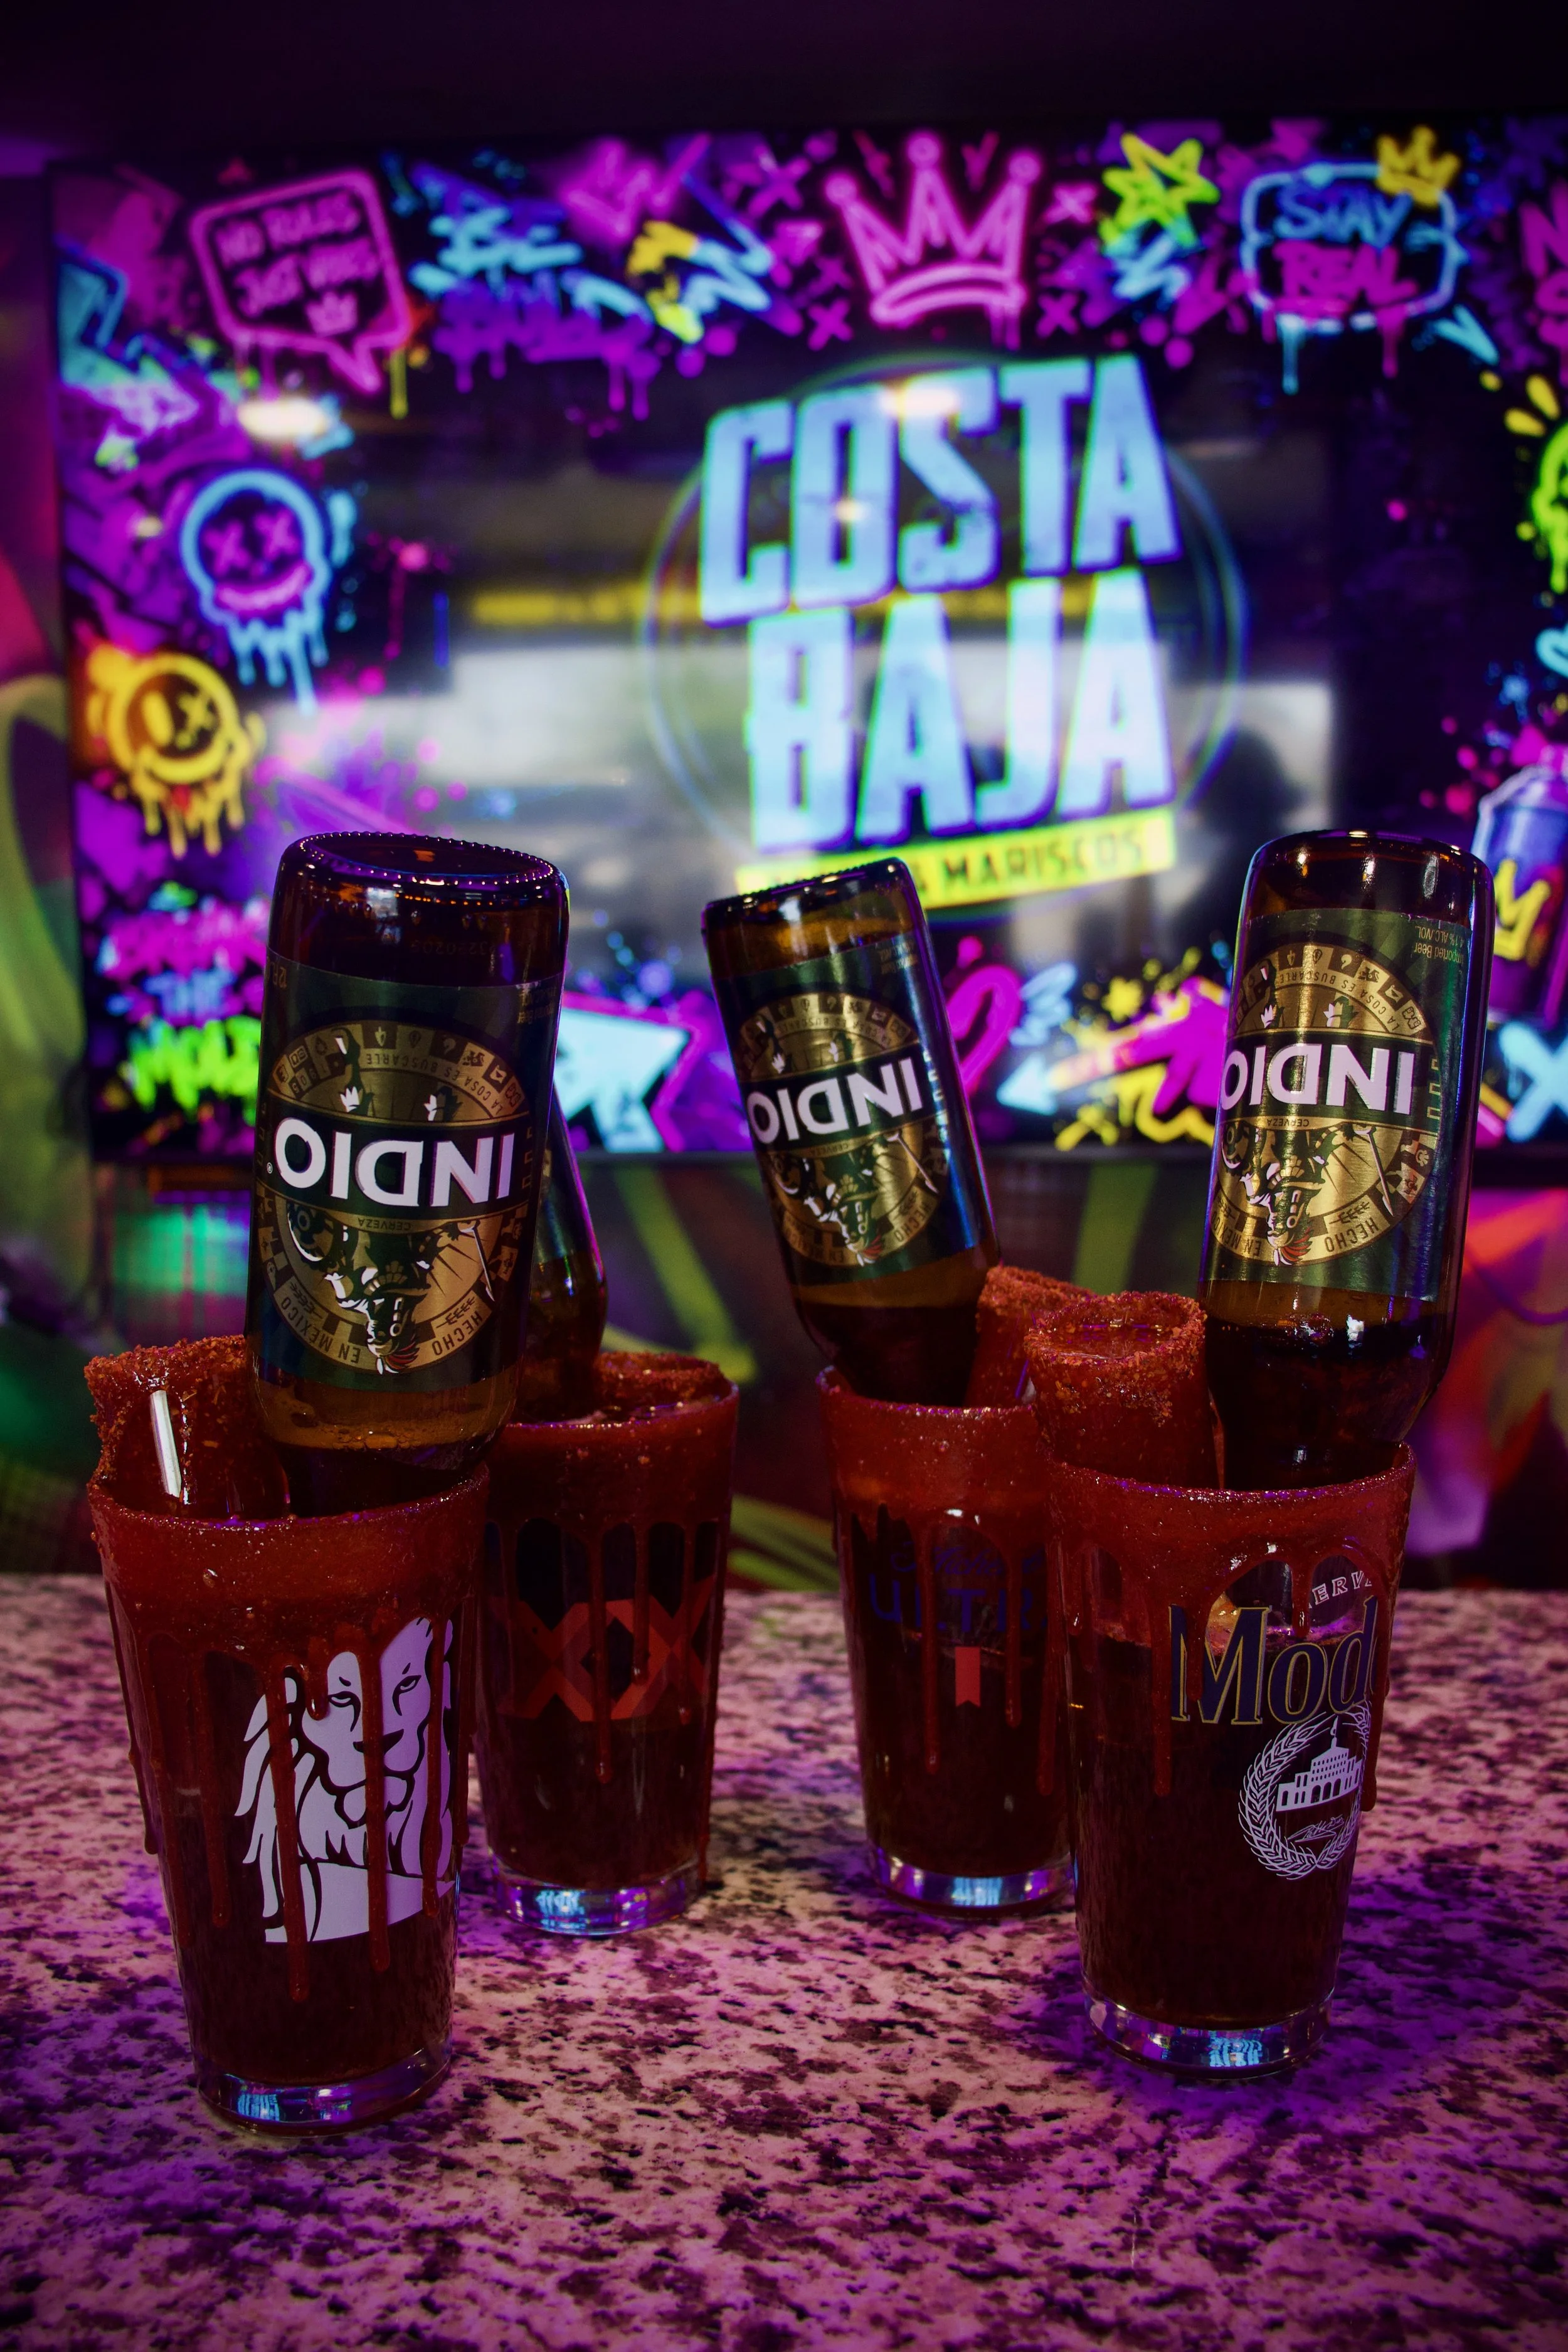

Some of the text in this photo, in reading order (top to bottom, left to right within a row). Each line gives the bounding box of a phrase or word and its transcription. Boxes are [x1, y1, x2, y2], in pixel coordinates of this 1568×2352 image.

[700, 353, 1182, 626] COSTA
[744, 566, 1177, 854] BAJA
[943, 830, 1142, 889] MARISCOS
[1414, 943, 1433, 958] Beer
[1278, 971, 1401, 1030] LA COSA ES BUSCARLE
[366, 1052, 504, 1115] LA COSA ES BUSCARLE
[746, 1056, 923, 1145] INDIO
[1221, 1044, 1415, 1116] INDIO
[1265, 1118, 1310, 1128] CERVEZA
[274, 1117, 516, 1208] INDIO
[358, 1217, 412, 1232] CERVEZA
[1244, 1239, 1262, 1257] EN
[1323, 1217, 1379, 1253] HECHO
[337, 1343, 361, 1364] EN
[432, 1310, 483, 1356] HECHO
[1169, 1595, 1379, 1725] Mod
